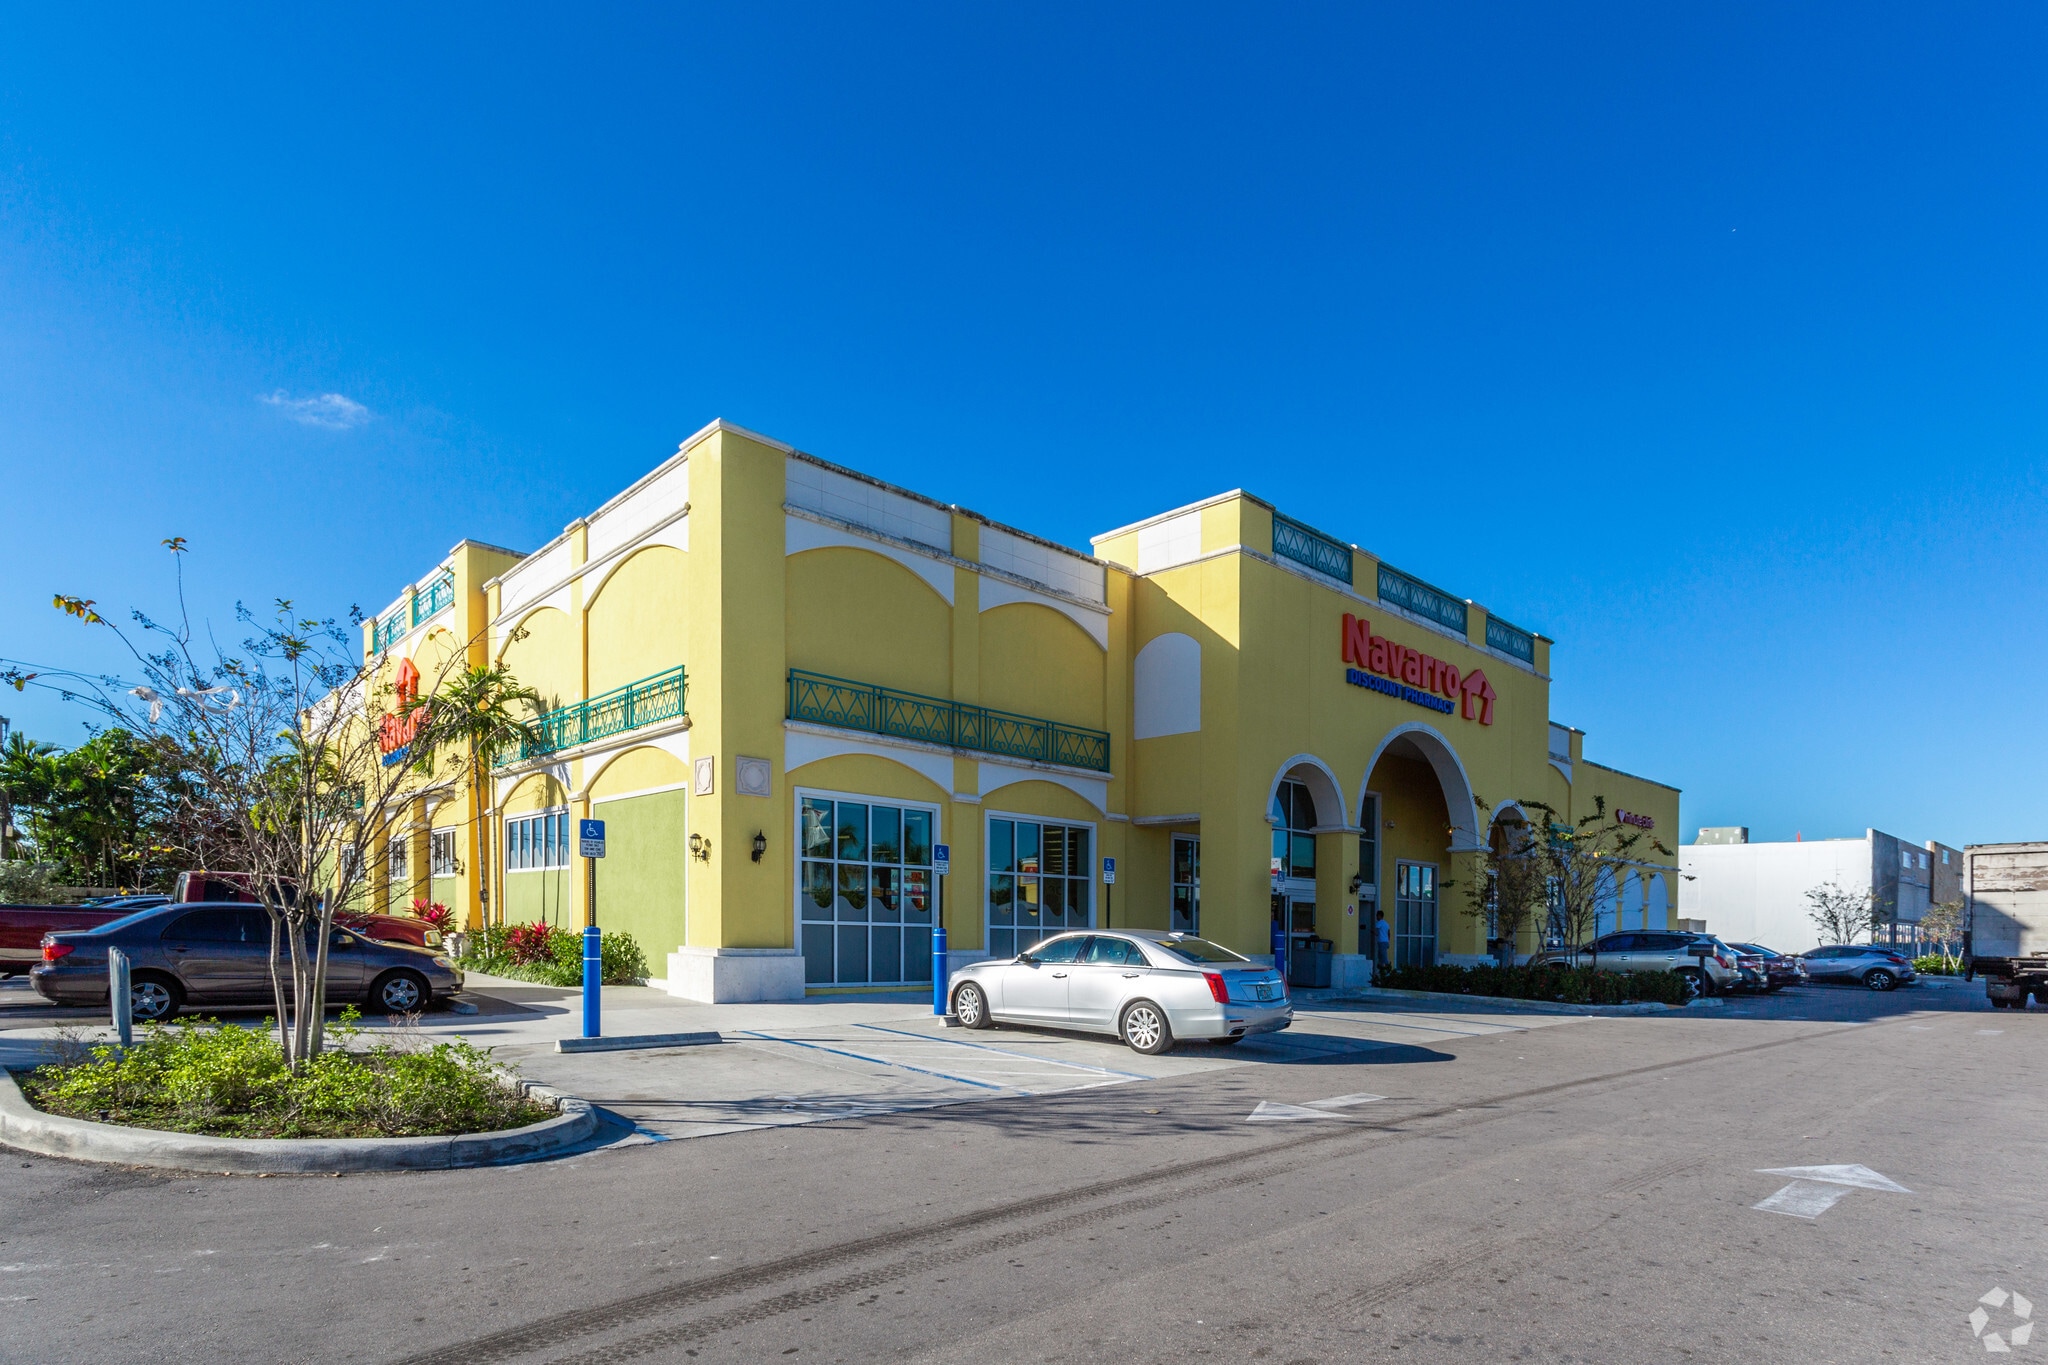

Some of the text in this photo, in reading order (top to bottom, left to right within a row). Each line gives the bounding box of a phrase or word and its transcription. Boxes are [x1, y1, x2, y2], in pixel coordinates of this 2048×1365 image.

[1342, 613, 1461, 699] Navarro
[1346, 668, 1456, 715] DISCOUNT PHARMACY
